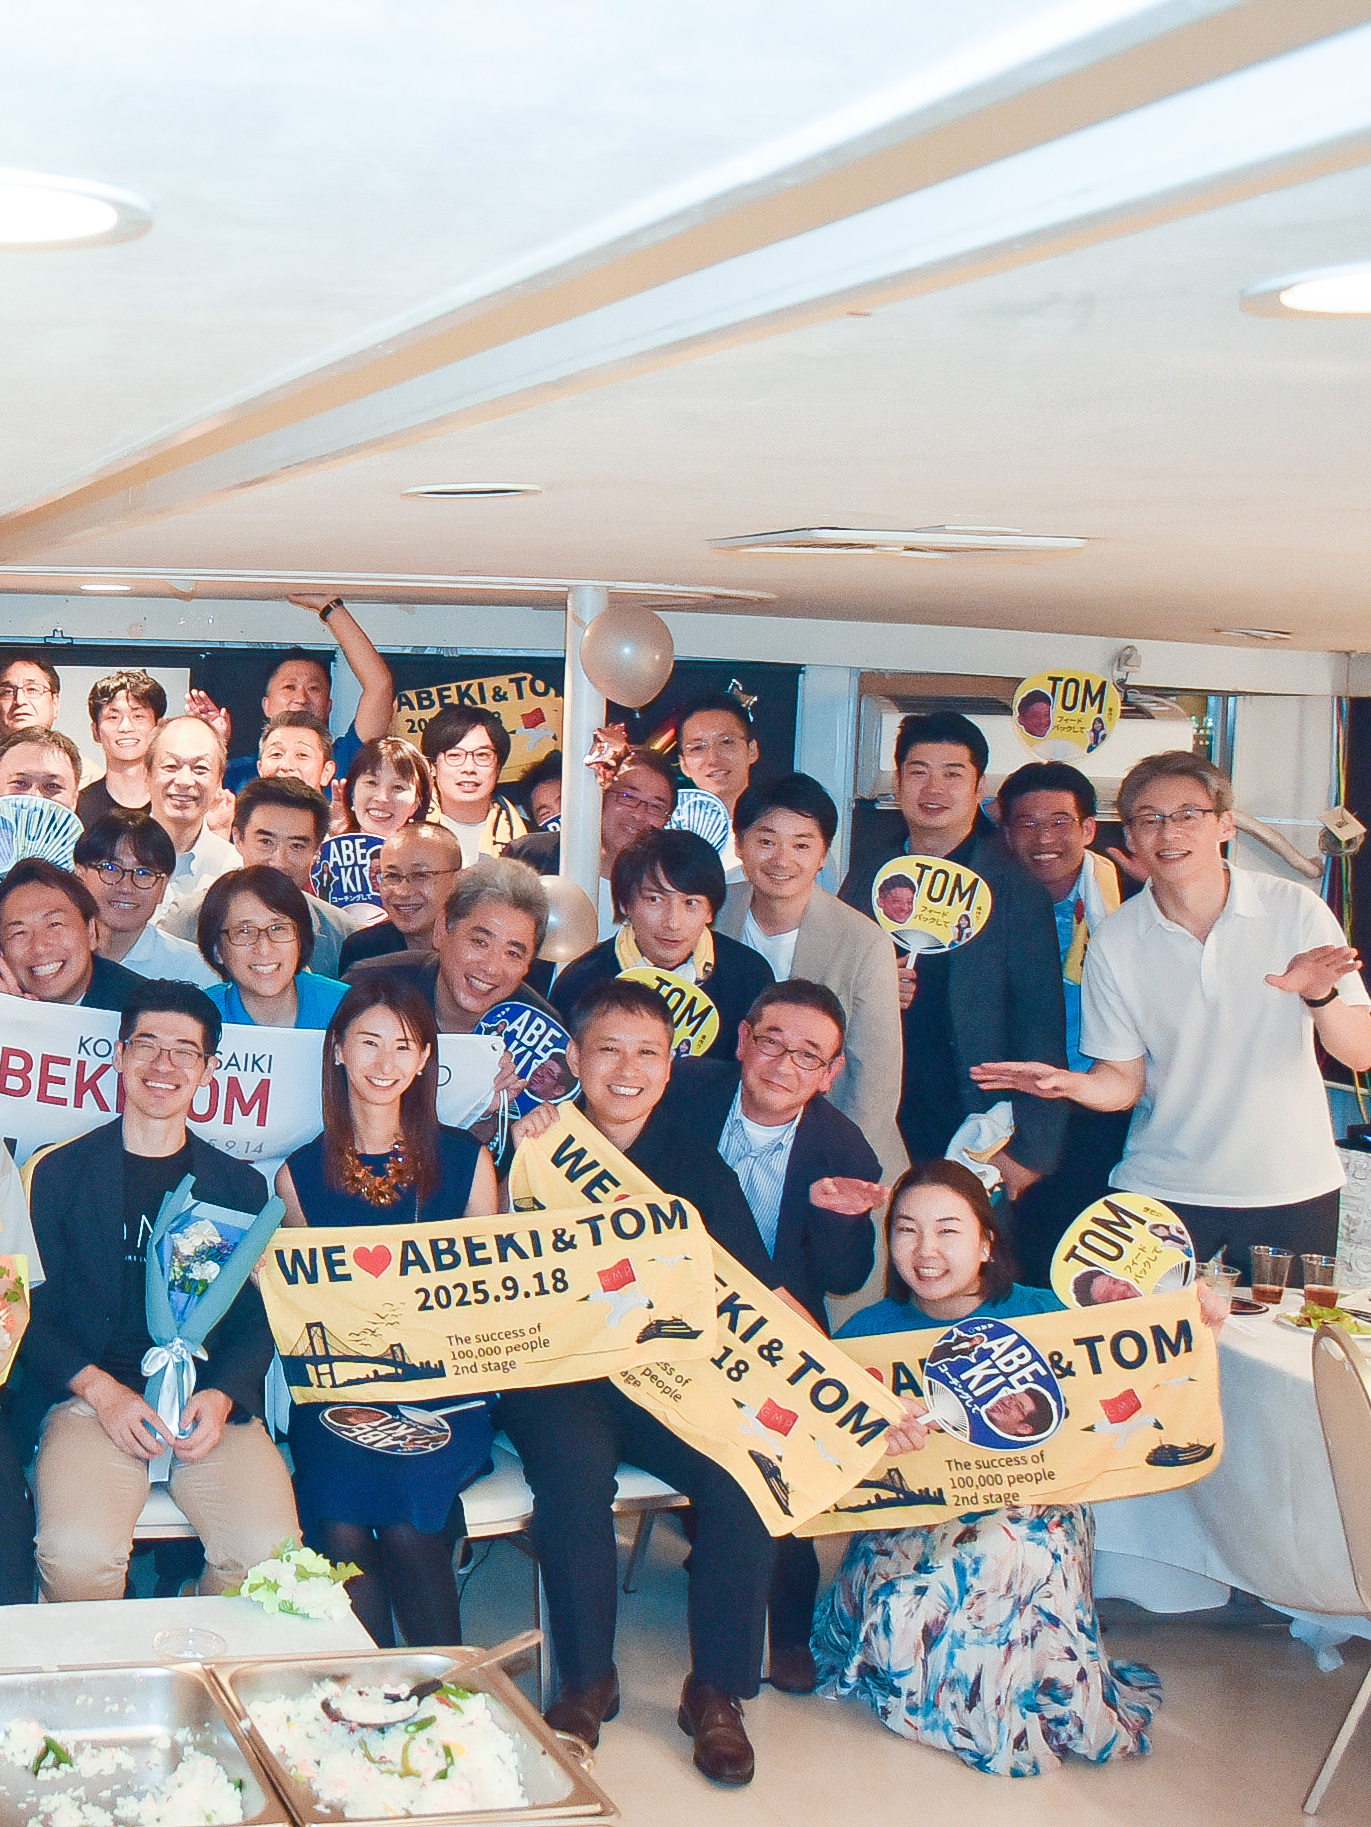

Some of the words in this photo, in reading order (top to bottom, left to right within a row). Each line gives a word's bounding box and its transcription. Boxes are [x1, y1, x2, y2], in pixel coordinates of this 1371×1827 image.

[397, 682, 487, 713] ABEKI
[491, 685, 509, 702] &
[1047, 676, 1107, 714] TOM
[330, 838, 368, 868] ABE
[340, 866, 362, 893] KI
[915, 862, 980, 912] TOM
[654, 975, 714, 1038] TOM
[506, 1009, 562, 1059] ABE
[550, 1134, 621, 1203] WE
[275, 1244, 352, 1286] WE
[398, 1230, 542, 1277] ABEKI
[552, 1226, 576, 1252] &
[576, 1199, 688, 1247] TOM
[1063, 1199, 1147, 1274] TOM
[415, 1268, 569, 1311] 2025.9.18
[446, 1333, 472, 1347] The
[475, 1327, 526, 1343] success
[528, 1323, 542, 1336] of
[450, 1346, 502, 1362] 100,000
[505, 1335, 550, 1356] people
[1050, 1351, 1076, 1379] &
[1073, 1319, 1194, 1375] TOM
[452, 1362, 480, 1376] 2nd
[482, 1359, 517, 1375] stage
[620, 1370, 641, 1387] age
[675, 1374, 692, 1387] of
[960, 1358, 1007, 1397] KI
[981, 1333, 1048, 1391] ABE
[640, 1367, 682, 1403] people
[757, 1338, 785, 1368] &
[786, 1350, 890, 1448] TOM
[945, 1458, 971, 1472] The
[974, 1455, 1028, 1470] success
[1031, 1450, 1046, 1465] of
[949, 1476, 1005, 1492] 100,000
[1007, 1468, 1056, 1488] people
[953, 1492, 980, 1507] 2nd
[984, 1490, 1020, 1507] stage
